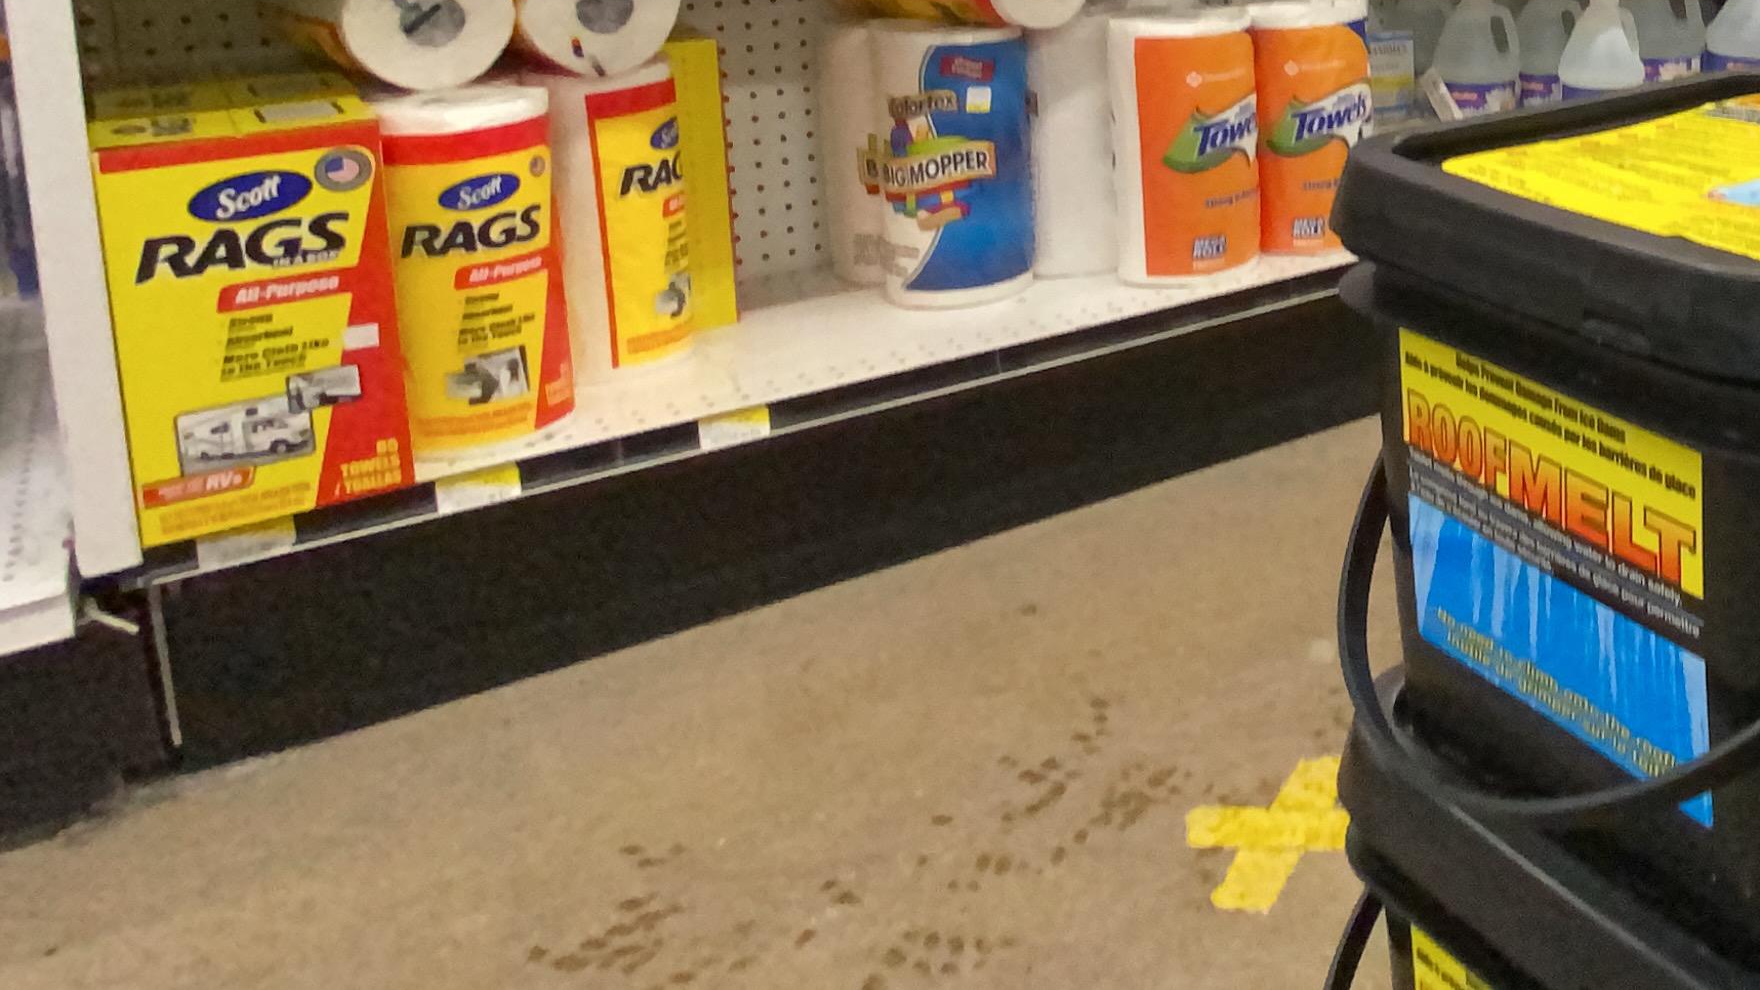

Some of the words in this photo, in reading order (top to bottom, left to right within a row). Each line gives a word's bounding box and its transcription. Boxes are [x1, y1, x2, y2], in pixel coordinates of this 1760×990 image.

[909, 150, 989, 184] MOPPER
[215, 174, 283, 220] Scott
[458, 172, 502, 210] Scott
[134, 211, 350, 286] RAGS
[400, 204, 541, 259] RAGS
[234, 275, 341, 306] All-Purpose
[1406, 387, 1697, 587] ROOFMELT
